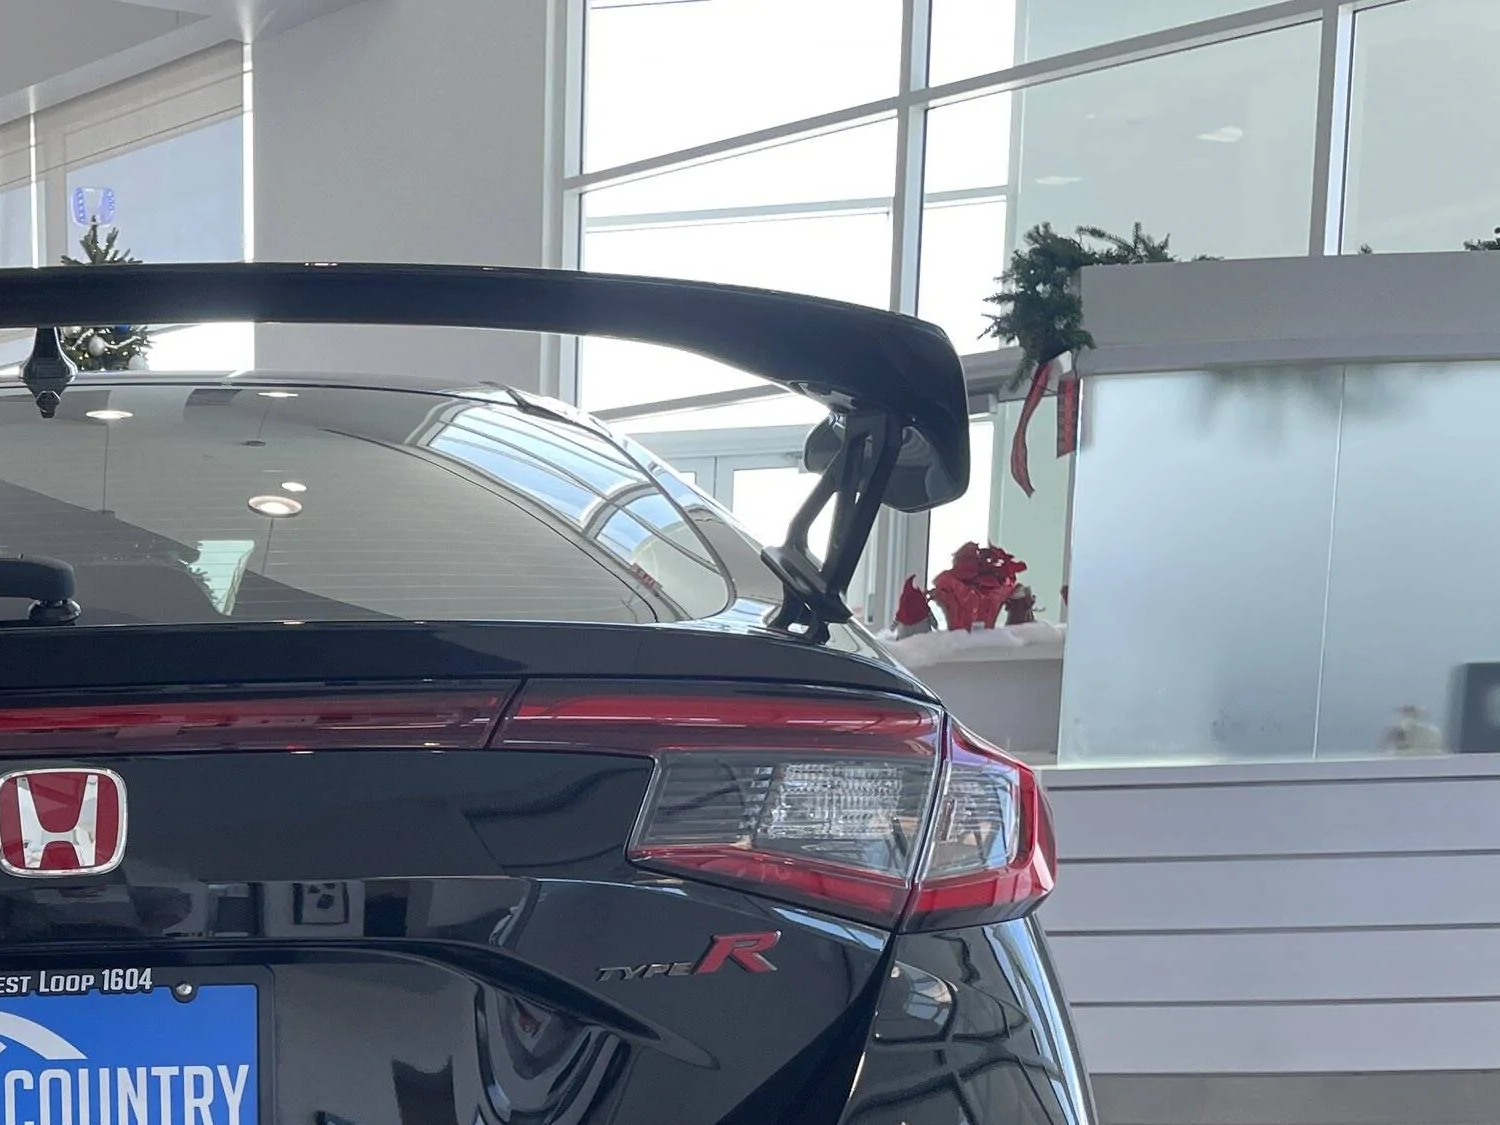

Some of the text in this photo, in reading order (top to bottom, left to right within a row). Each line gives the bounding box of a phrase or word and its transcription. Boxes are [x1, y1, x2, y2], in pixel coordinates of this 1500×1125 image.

[597, 930, 782, 981] TYPE R
[101, 968, 152, 992] 1604
